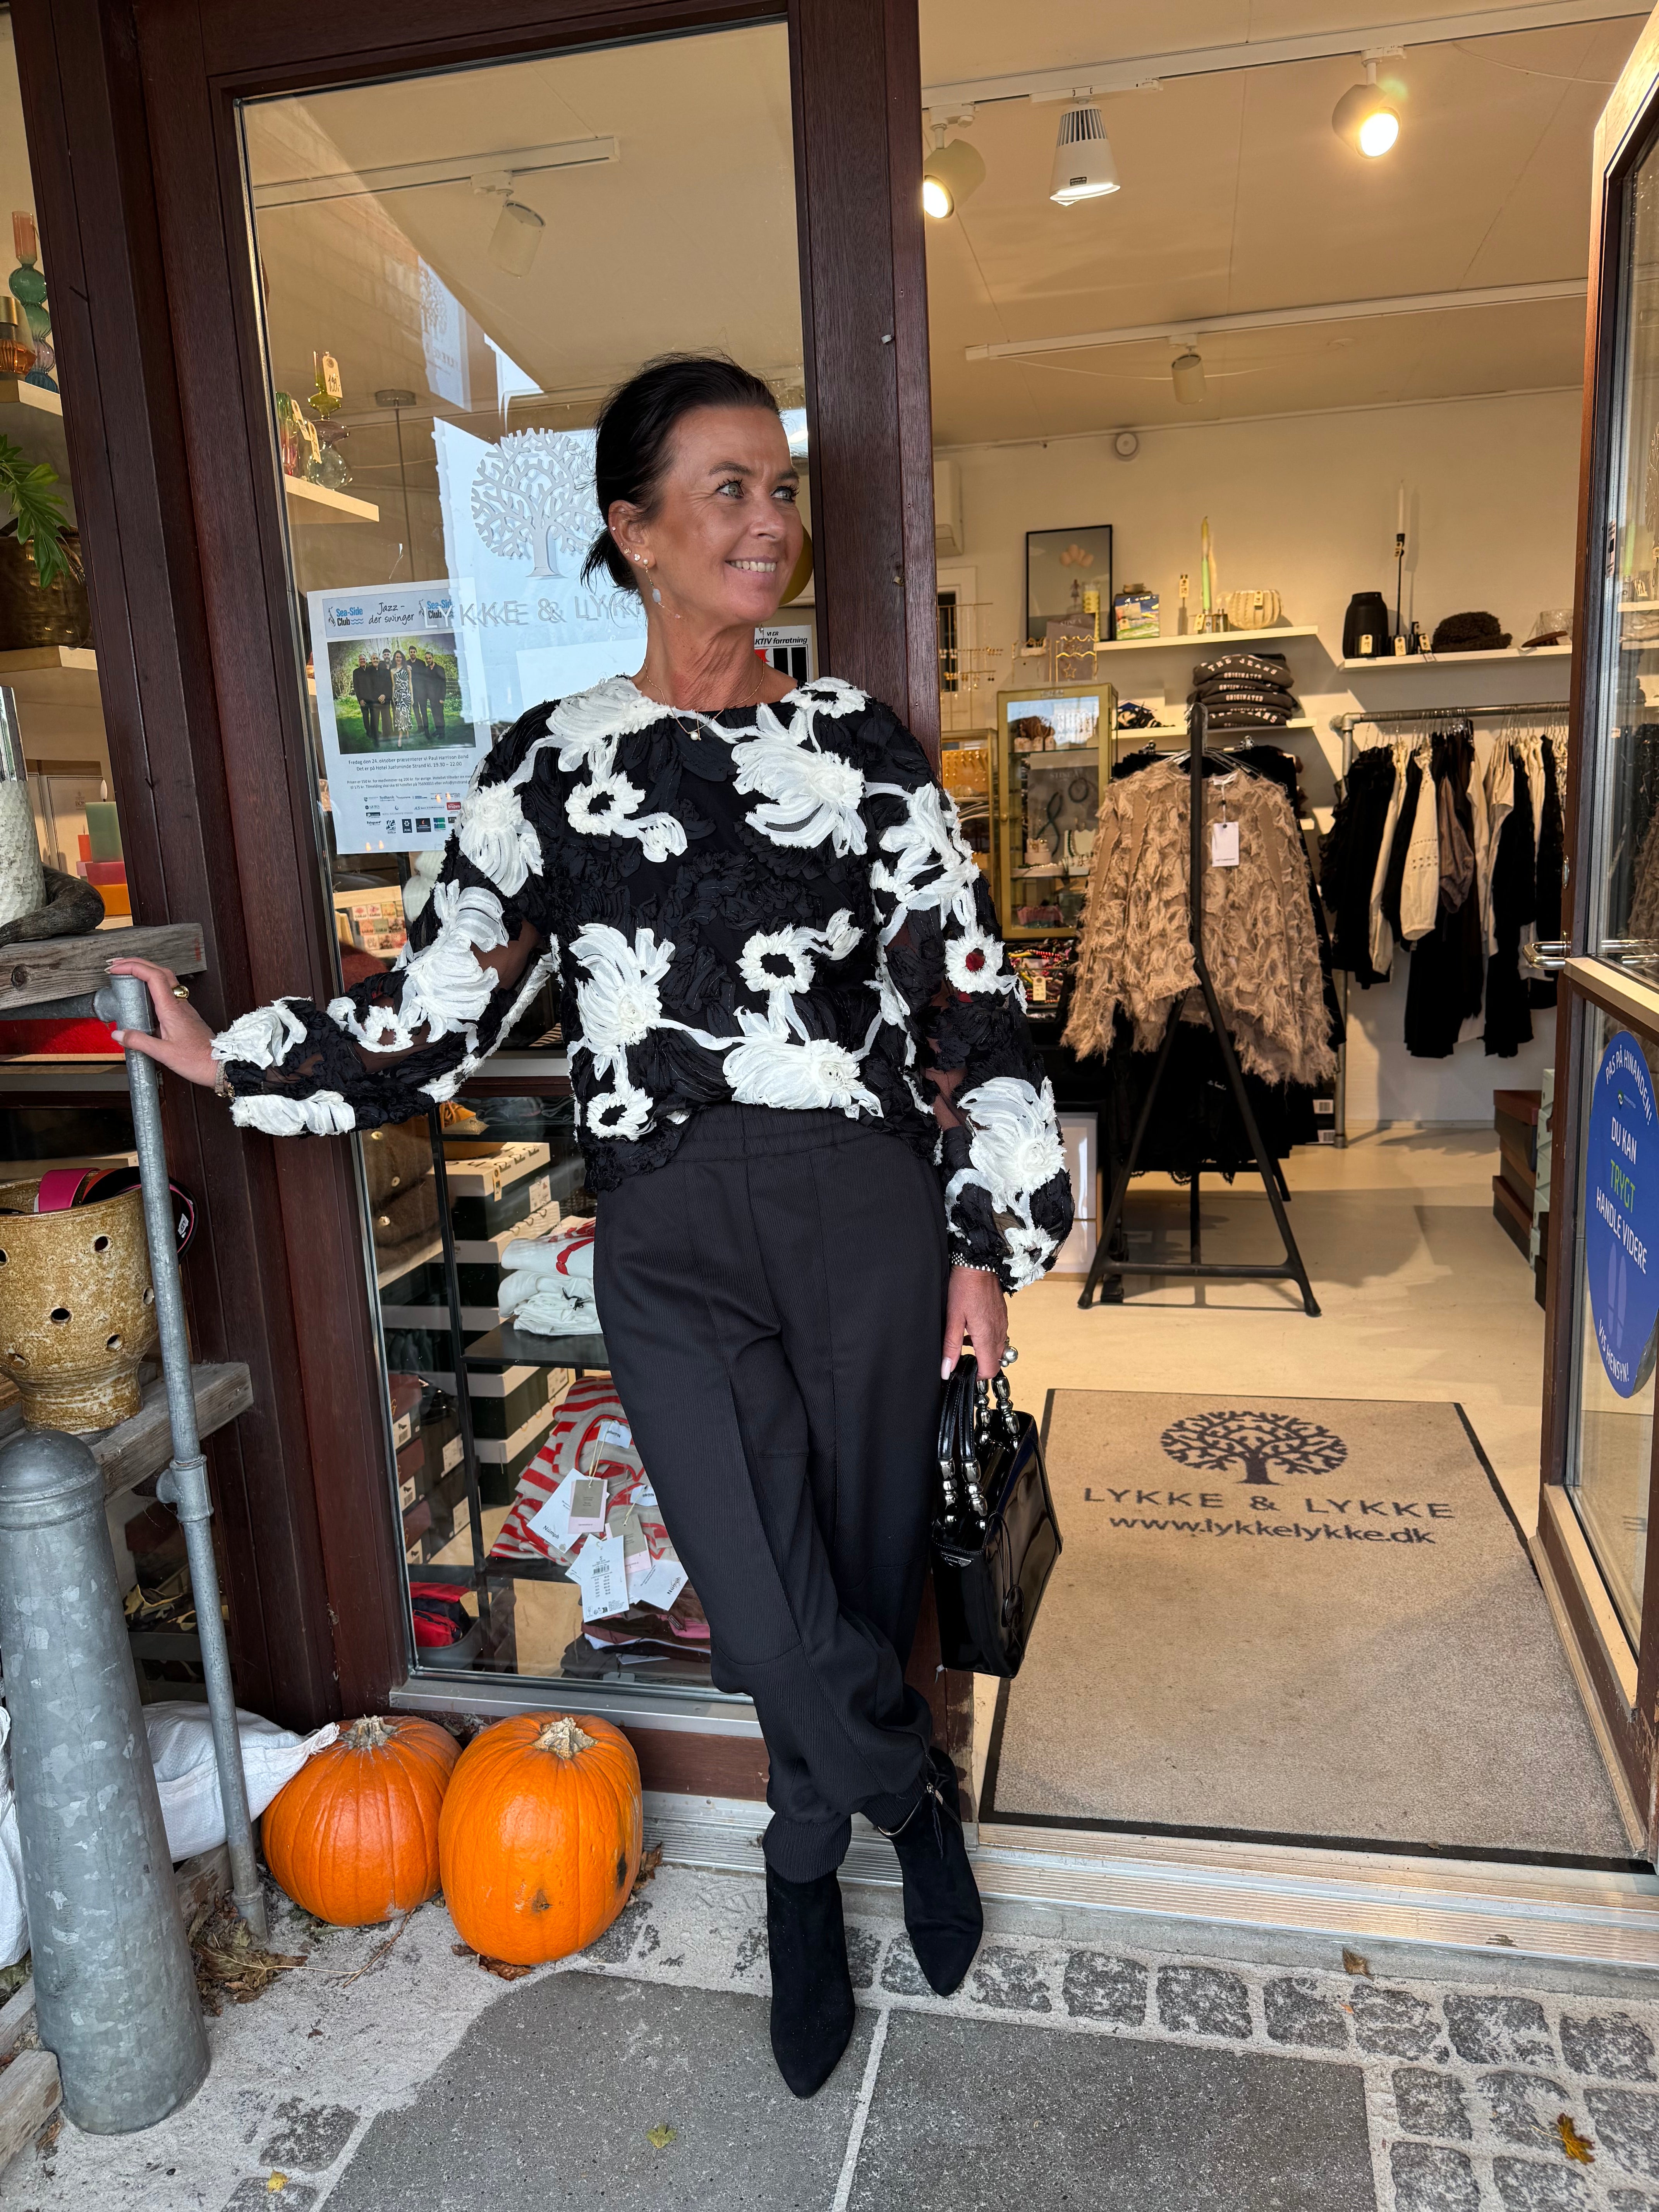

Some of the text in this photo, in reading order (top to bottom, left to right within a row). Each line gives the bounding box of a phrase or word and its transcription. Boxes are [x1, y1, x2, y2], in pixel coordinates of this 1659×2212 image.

[336, 606, 363, 617] Sea-Side
[377, 602, 398, 615] Jazz
[424, 600, 518, 628] LYKKE
[538, 598, 555, 621] &
[427, 599, 453, 610] Sea-Sid
[428, 610, 442, 619] Club
[337, 617, 350, 626] Club
[368, 613, 414, 625] der swinger
[1207, 658, 1278, 675] THE JEANS
[1606, 1044, 1652, 1126] PAS PÅ HINANDEN!
[1611, 1116, 1637, 1165] DU KAN
[1611, 1159, 1636, 1214] TRYGT
[1596, 1186, 1647, 1275] HANDLE VIDERE
[1599, 1319, 1629, 1382] VIS HENSYN!
[1084, 1487, 1455, 1519] LYKKE & LYKKE
[1109, 1517, 1436, 1544] www.lykkelykke.dk
